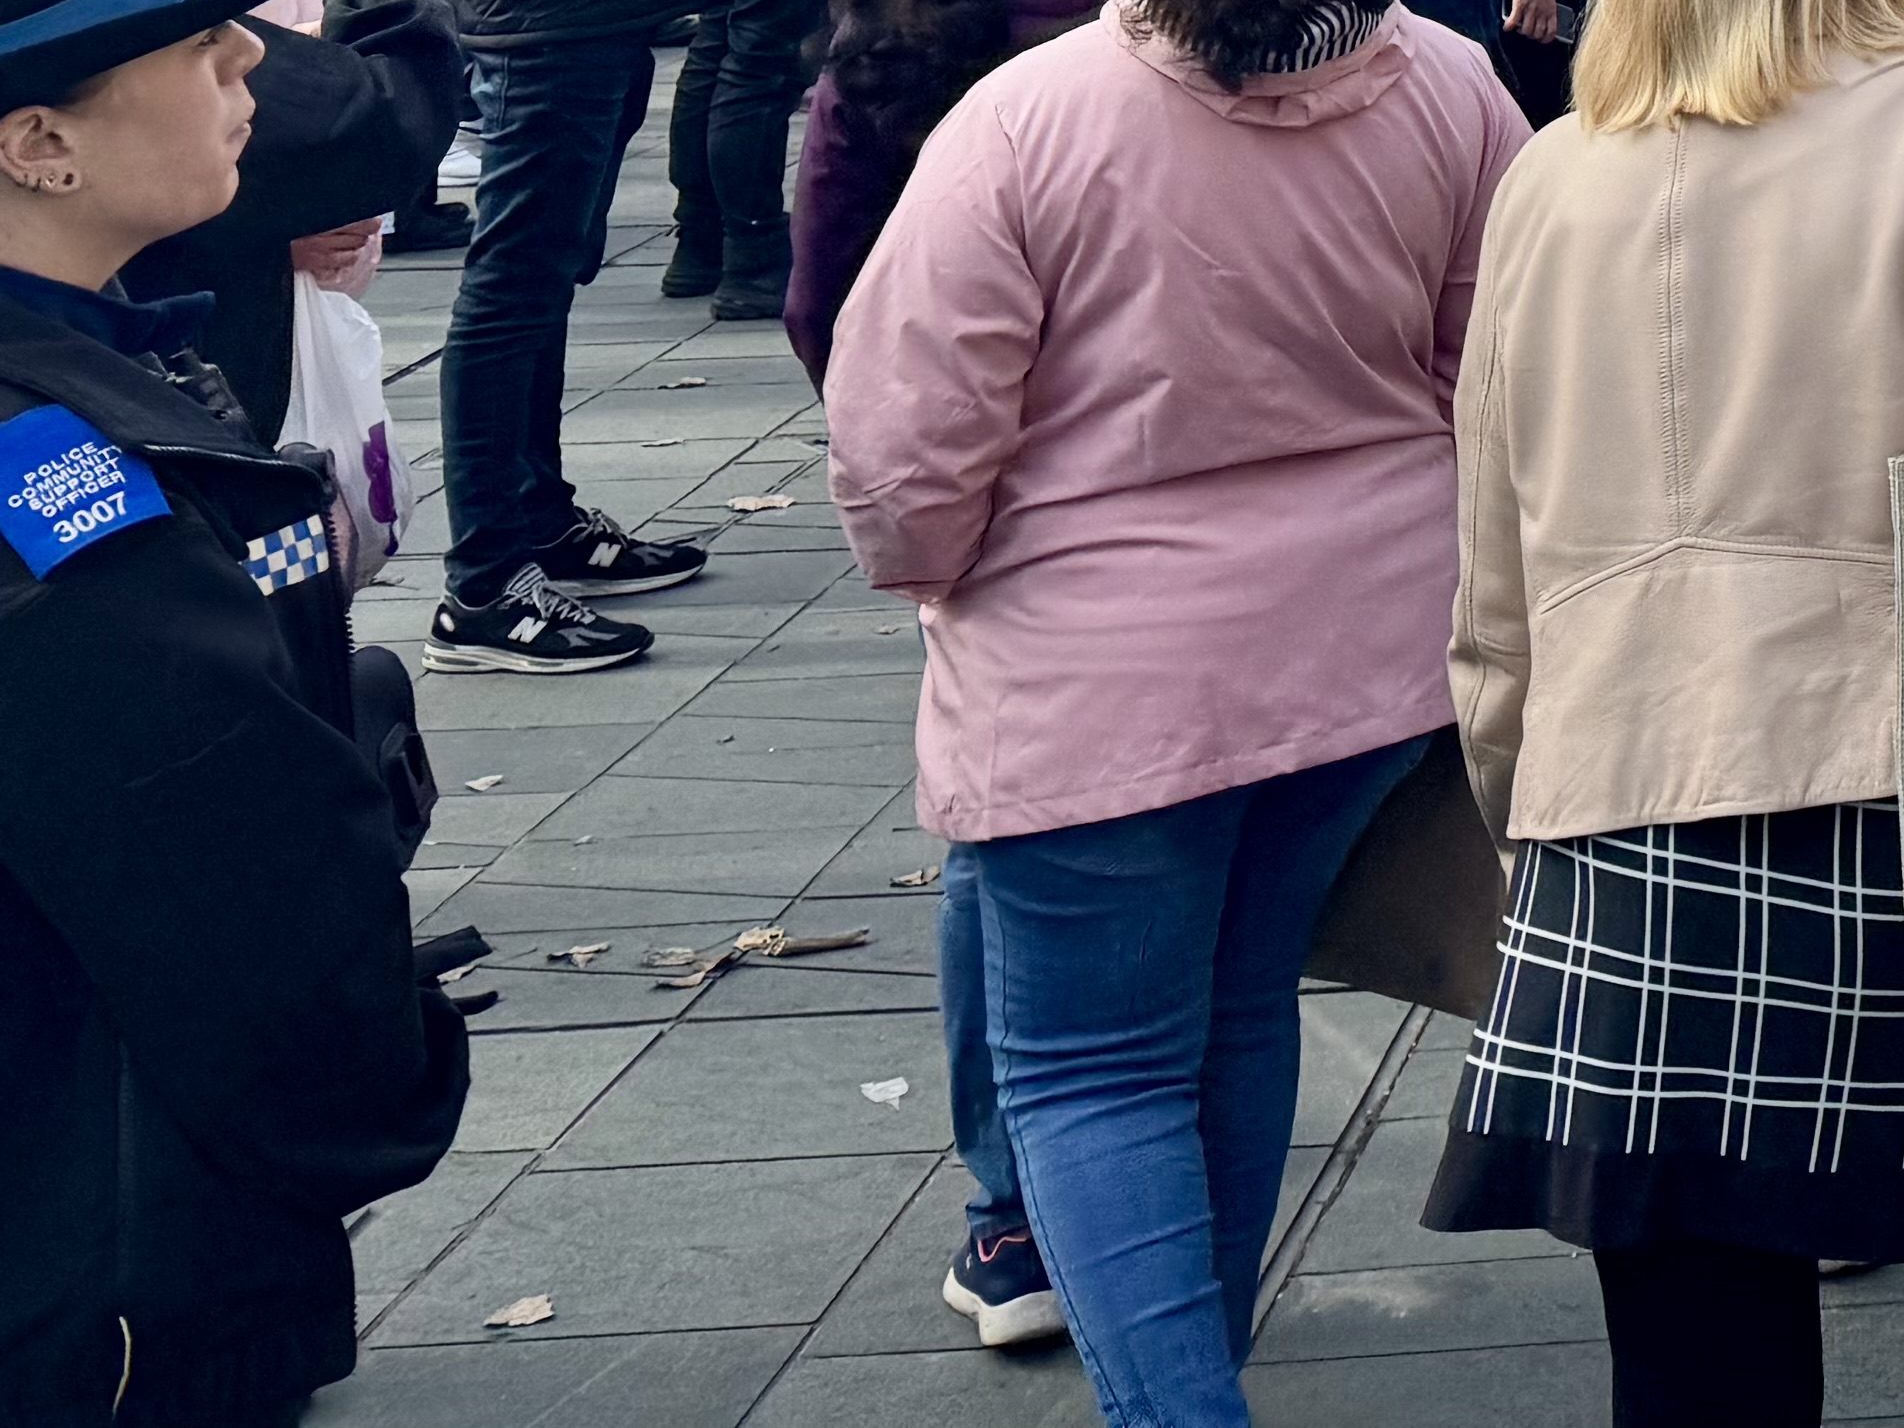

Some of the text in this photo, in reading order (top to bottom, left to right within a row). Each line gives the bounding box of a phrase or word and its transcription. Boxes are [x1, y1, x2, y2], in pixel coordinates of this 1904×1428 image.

[23, 442, 98, 485] POLICE
[28, 457, 120, 511] SUPPORT
[42, 470, 126, 518] OFFICER
[53, 491, 127, 543] 3007
[507, 616, 548, 644] N
